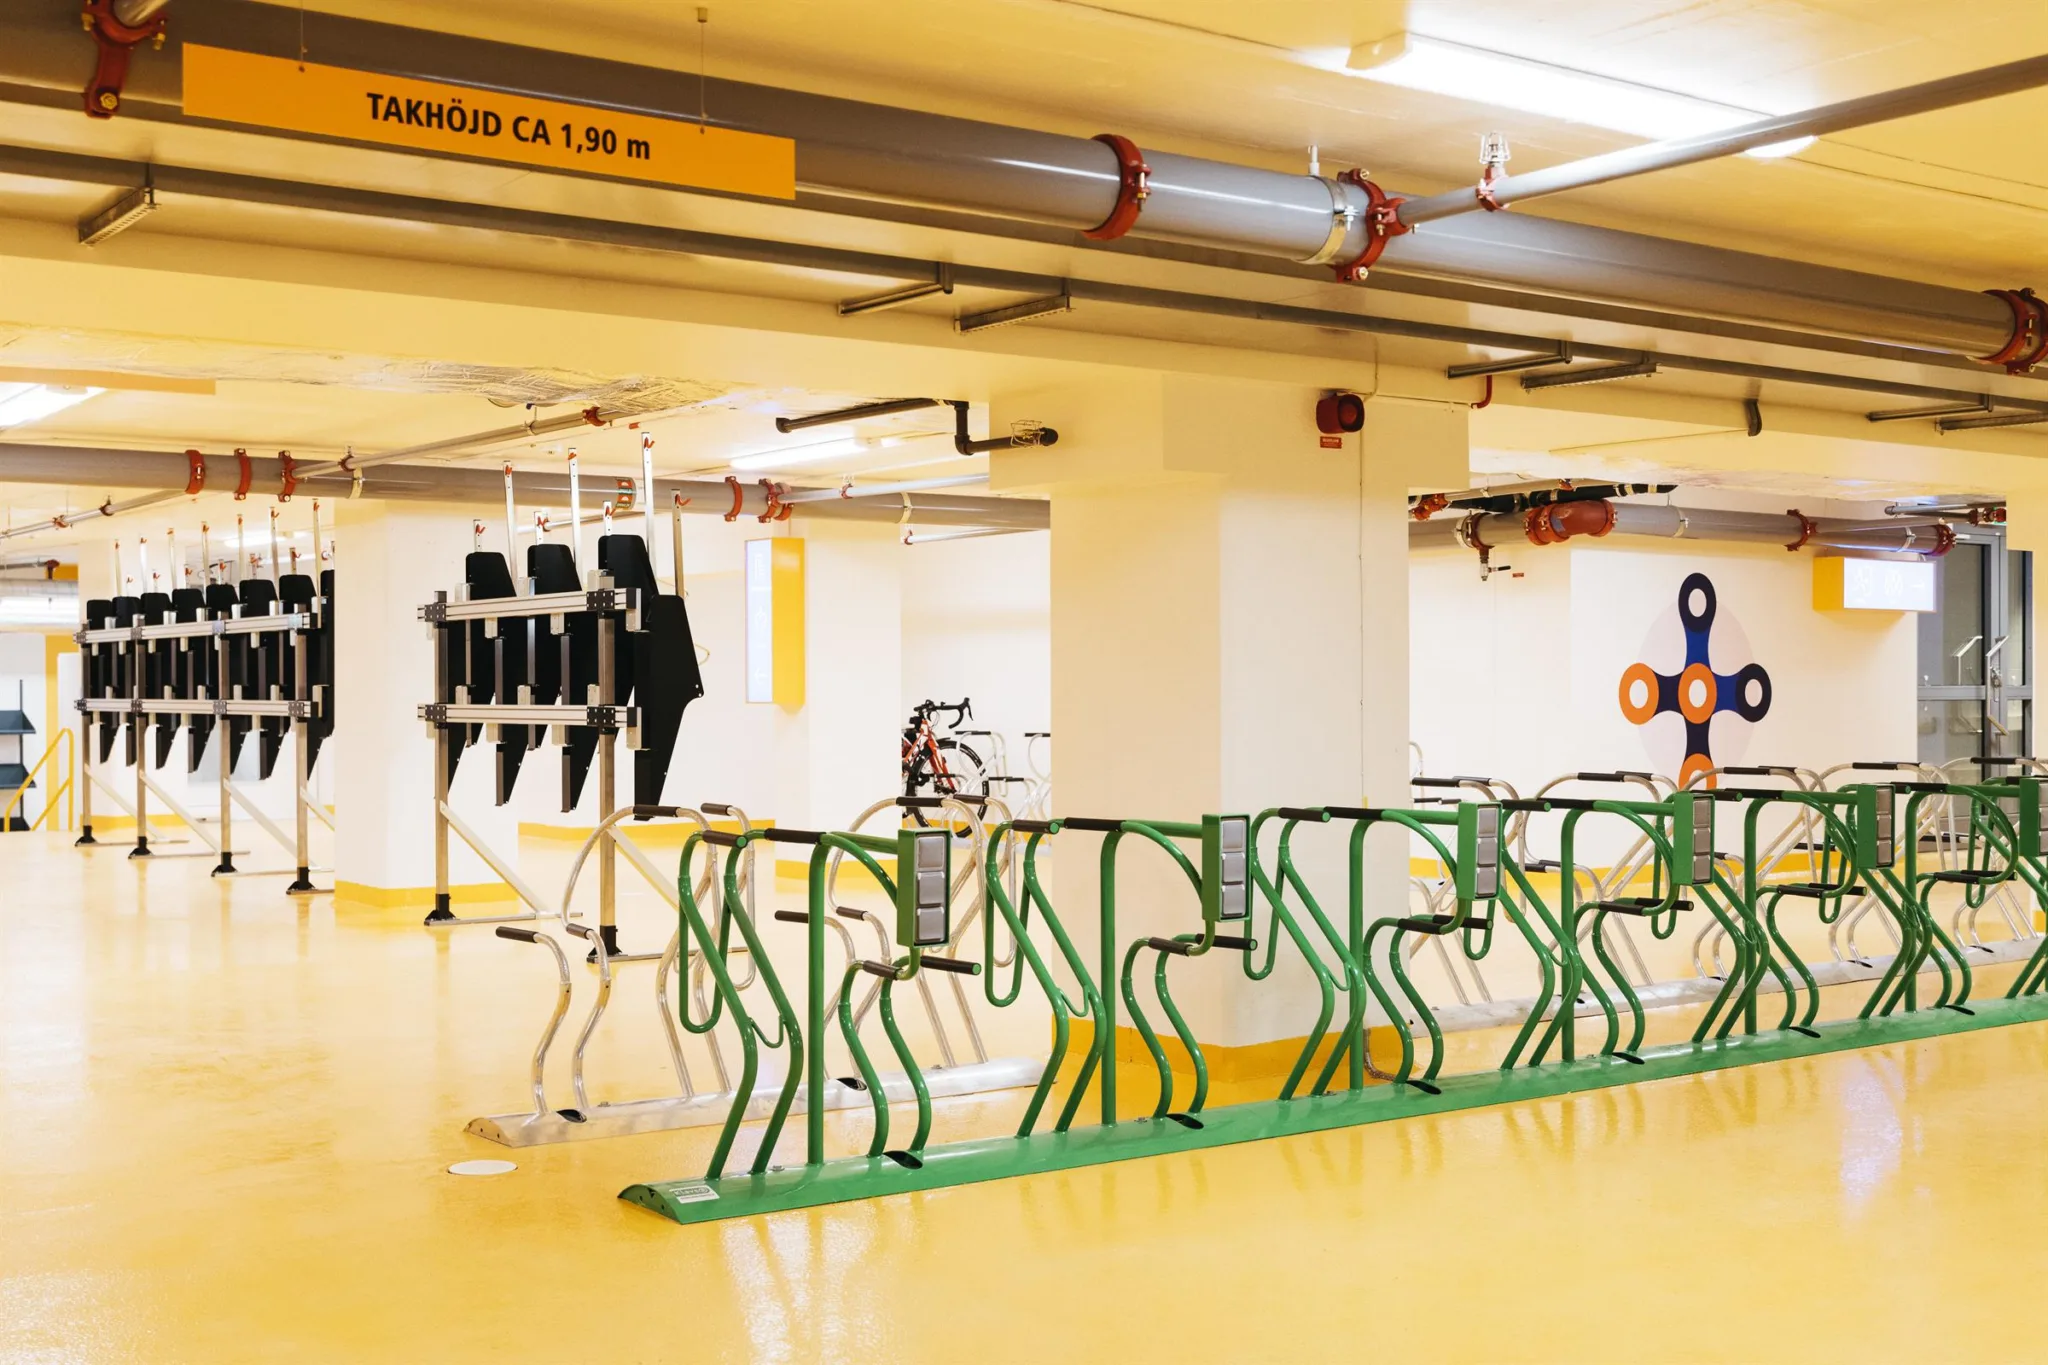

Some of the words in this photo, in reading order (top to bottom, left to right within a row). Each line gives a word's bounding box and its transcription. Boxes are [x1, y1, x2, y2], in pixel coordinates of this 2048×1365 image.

[367, 93, 502, 137] TAKHÖJD
[512, 117, 551, 145] CA
[561, 124, 617, 155] 1,90
[627, 140, 650, 160] m
